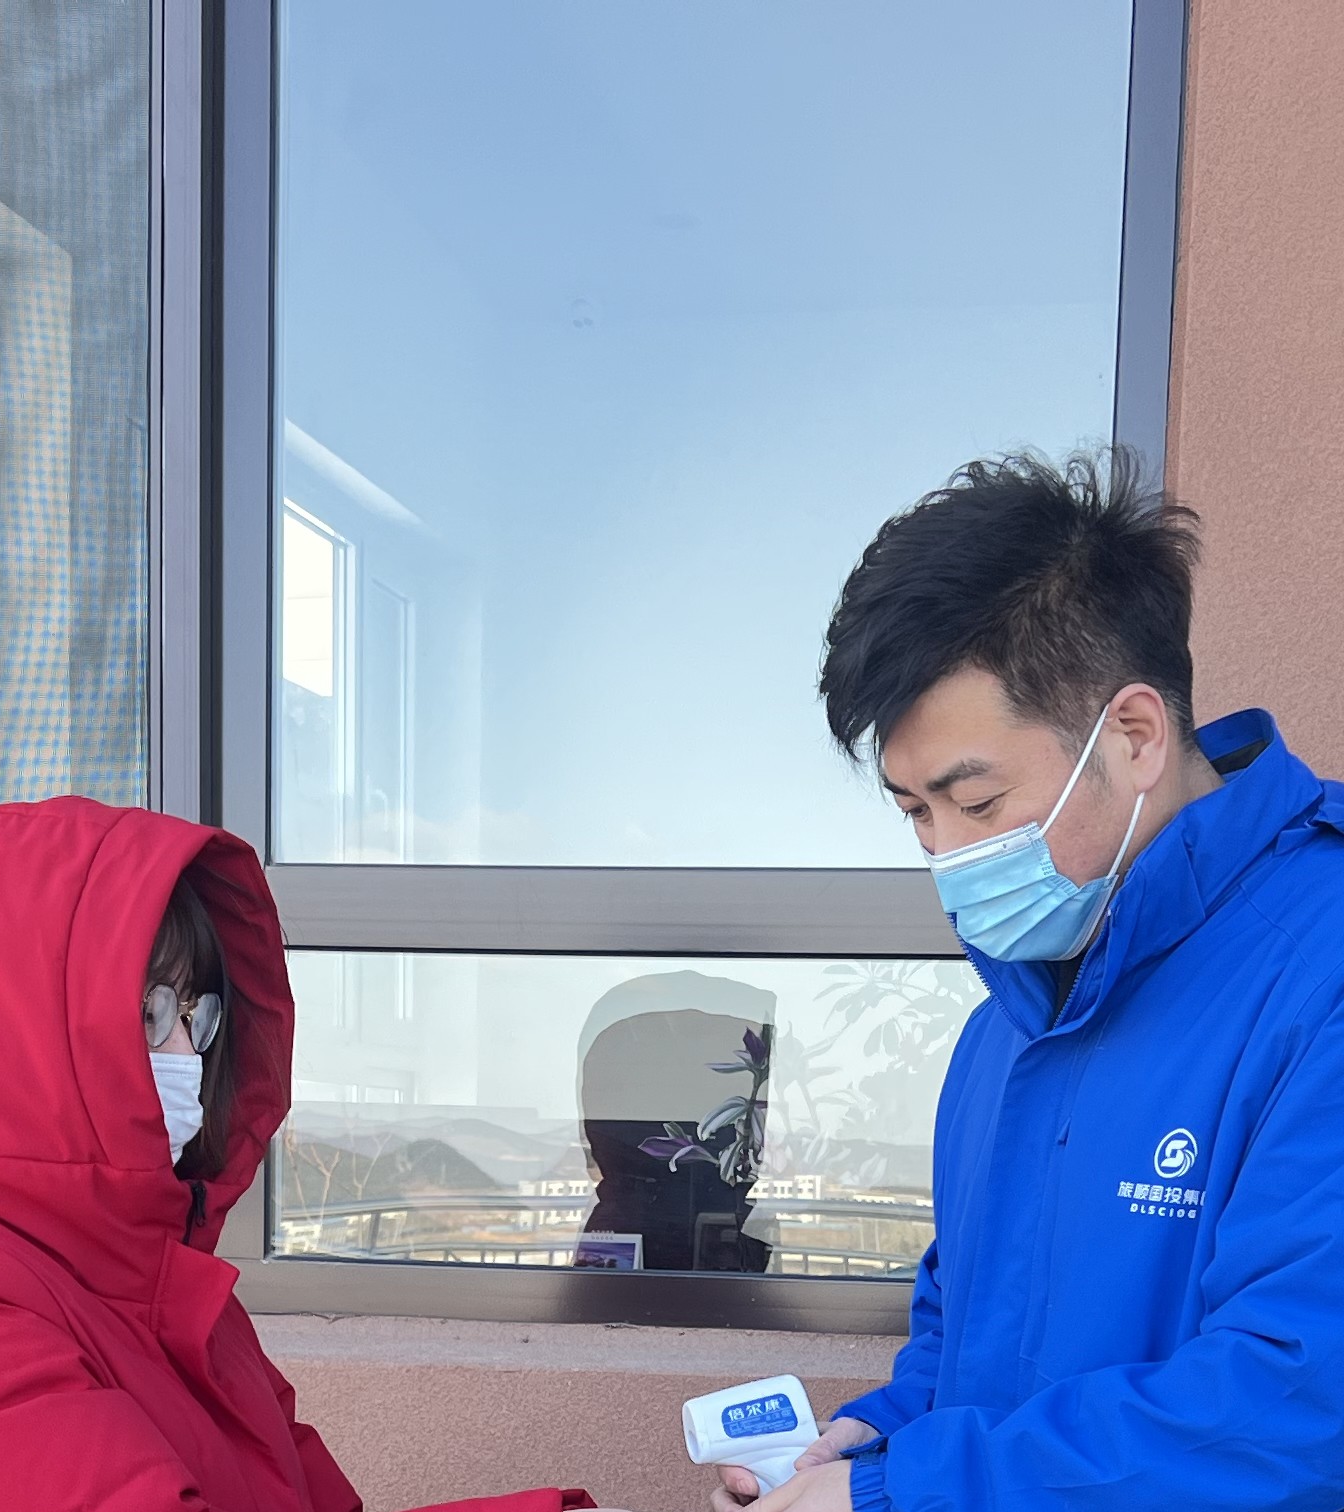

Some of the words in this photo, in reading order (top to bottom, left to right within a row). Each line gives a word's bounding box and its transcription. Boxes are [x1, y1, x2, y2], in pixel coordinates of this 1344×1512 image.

[1117, 1181, 1206, 1206] 旅顺国投集
